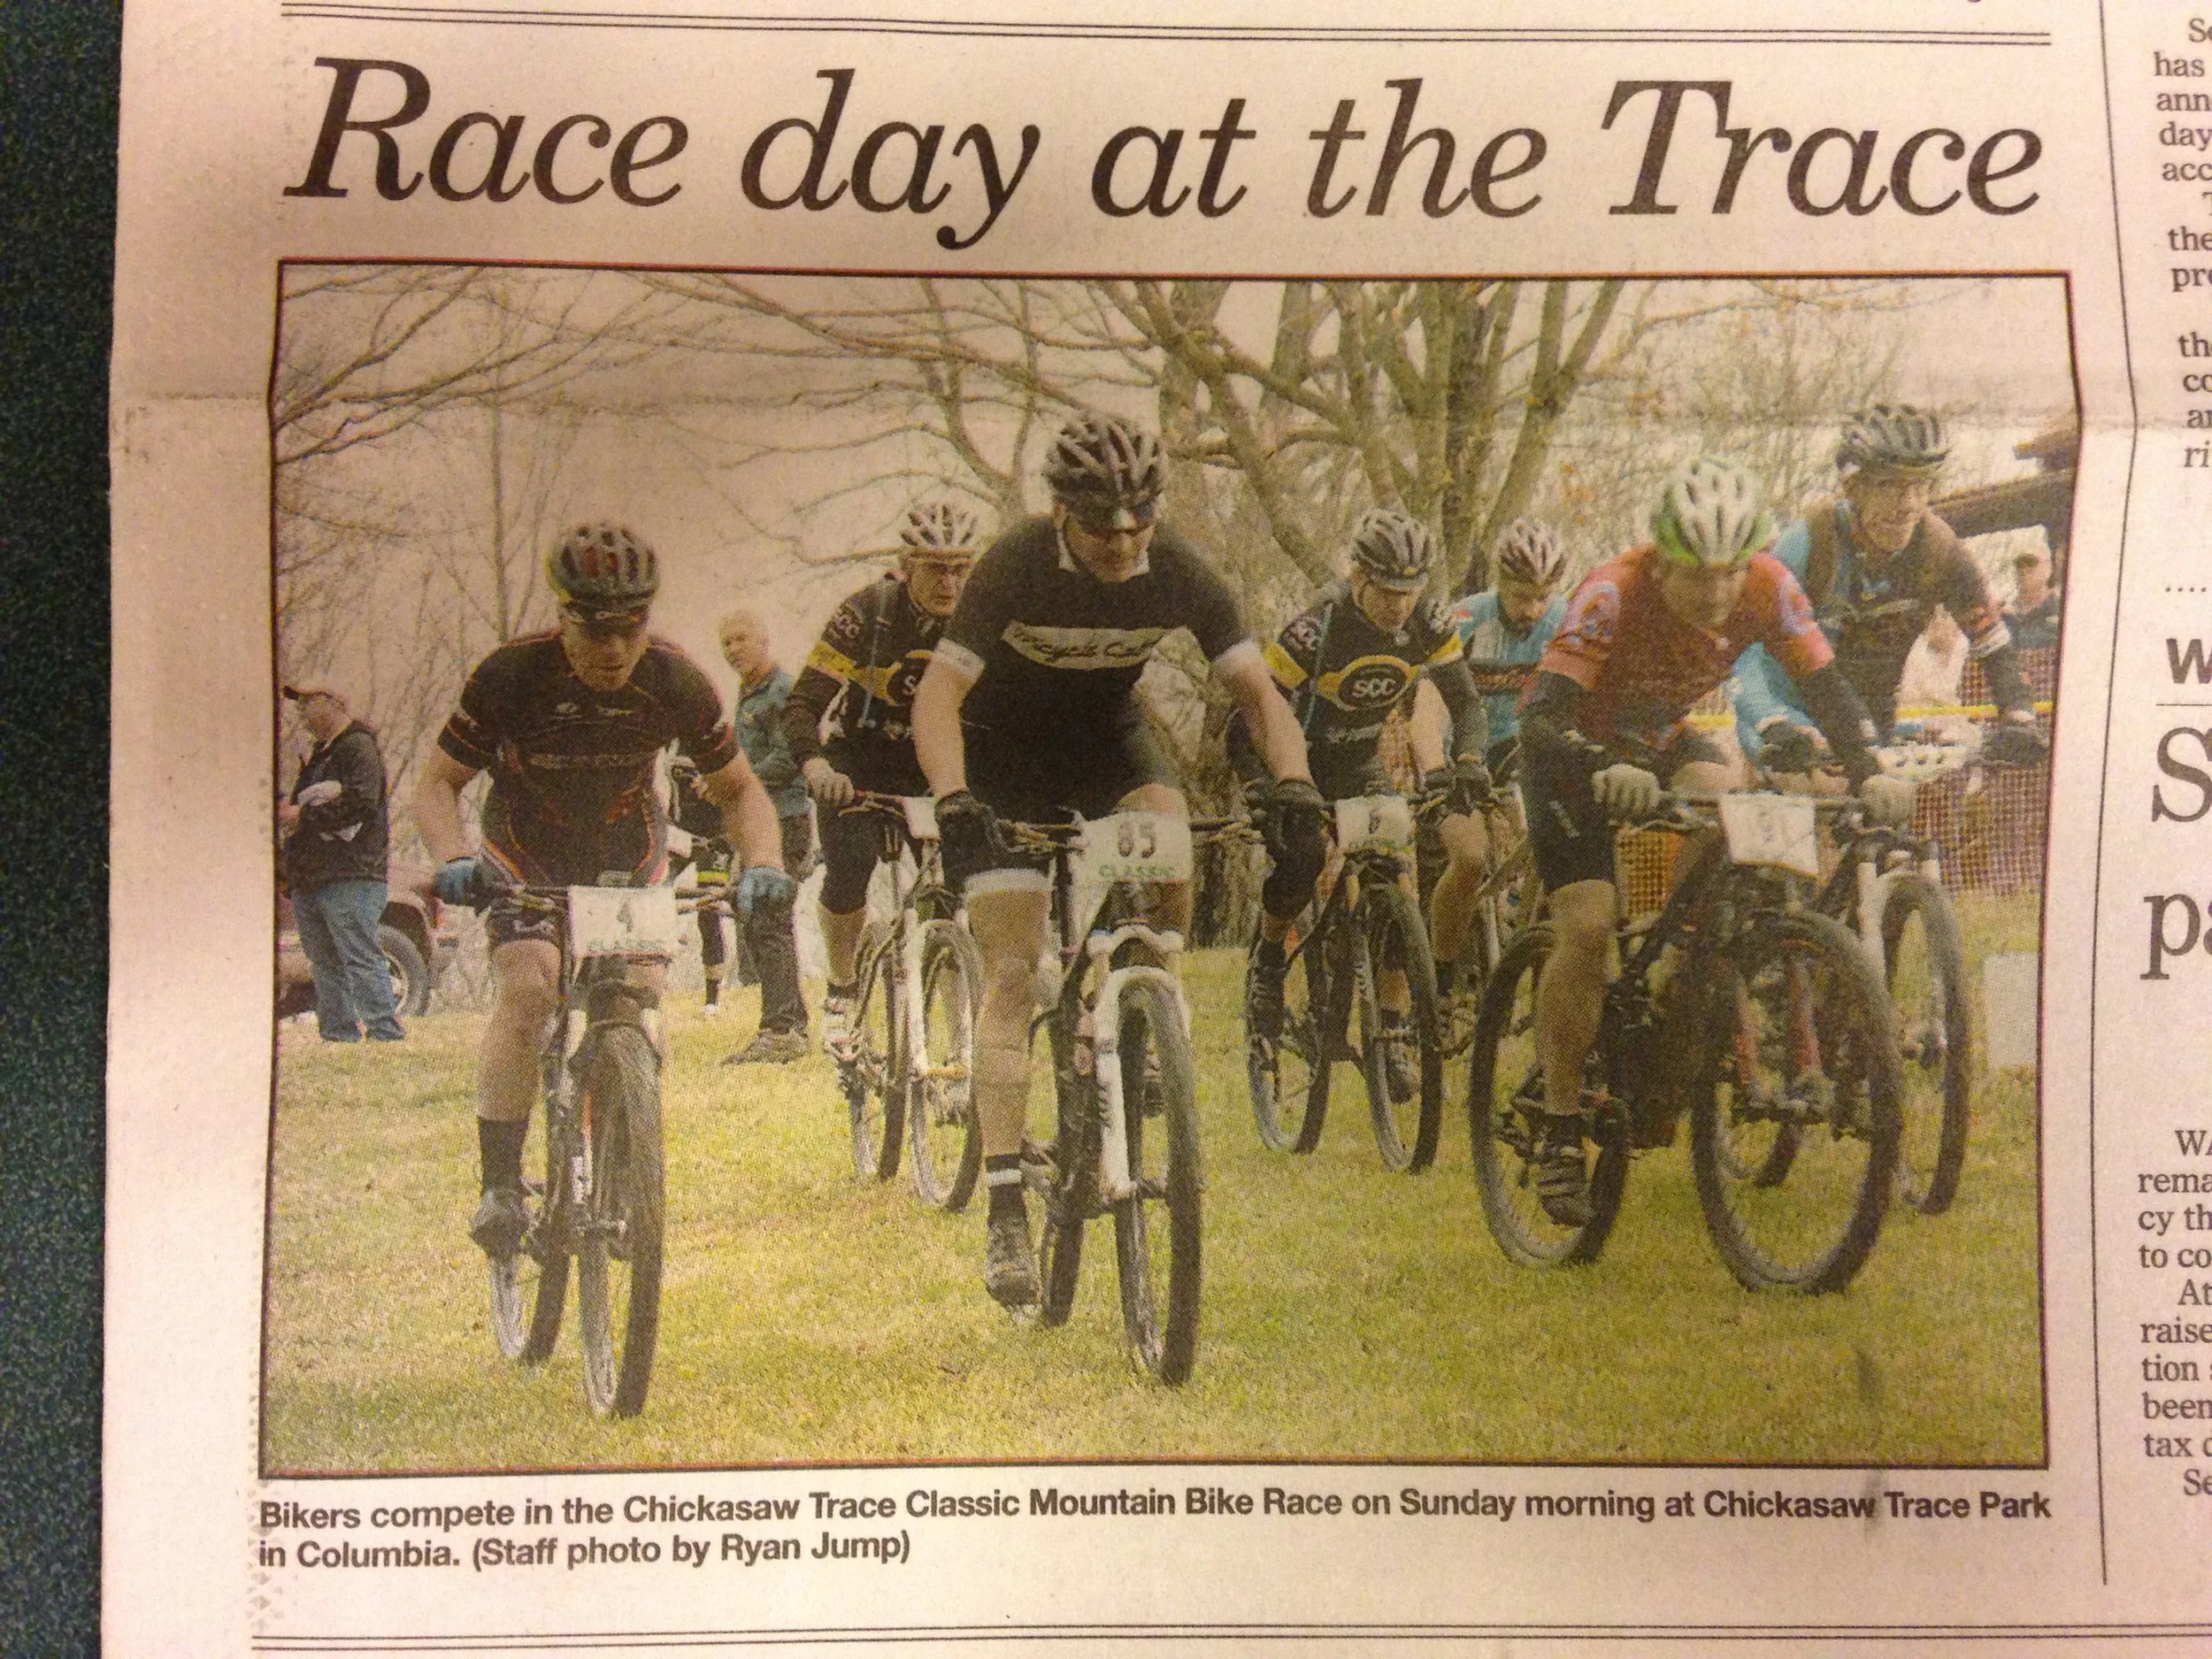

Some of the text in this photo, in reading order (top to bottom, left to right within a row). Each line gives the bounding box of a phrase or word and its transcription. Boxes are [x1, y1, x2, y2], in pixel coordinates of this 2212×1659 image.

[2154, 50, 2205, 78] has
[2156, 92, 2212, 112] ann
[2159, 120, 2212, 151] day
[281, 56, 2043, 251] Race day at the Trace
[2162, 163, 2212, 182] acc
[2168, 226, 2212, 252] the
[2170, 267, 2212, 294] pr
[2177, 331, 2212, 358] th
[2140, 894, 2212, 979] p
[2138, 1210, 2175, 1237] cy
[2138, 1243, 2212, 1270] to co
[2140, 1316, 2212, 1344] raise
[2141, 1353, 2200, 1382] tion
[2141, 1391, 2212, 1420] been
[2143, 1432, 2193, 1459] tax
[2183, 1468, 2212, 1497] Se
[258, 1486, 2052, 1534] Bikers compete in the Chickasaw Trace Classic Mountain Bike Race on Sunday morning at Chickasaw Trace Park
[258, 1528, 910, 1572] in Columbia. (Staff photo by Ryan Jump)
